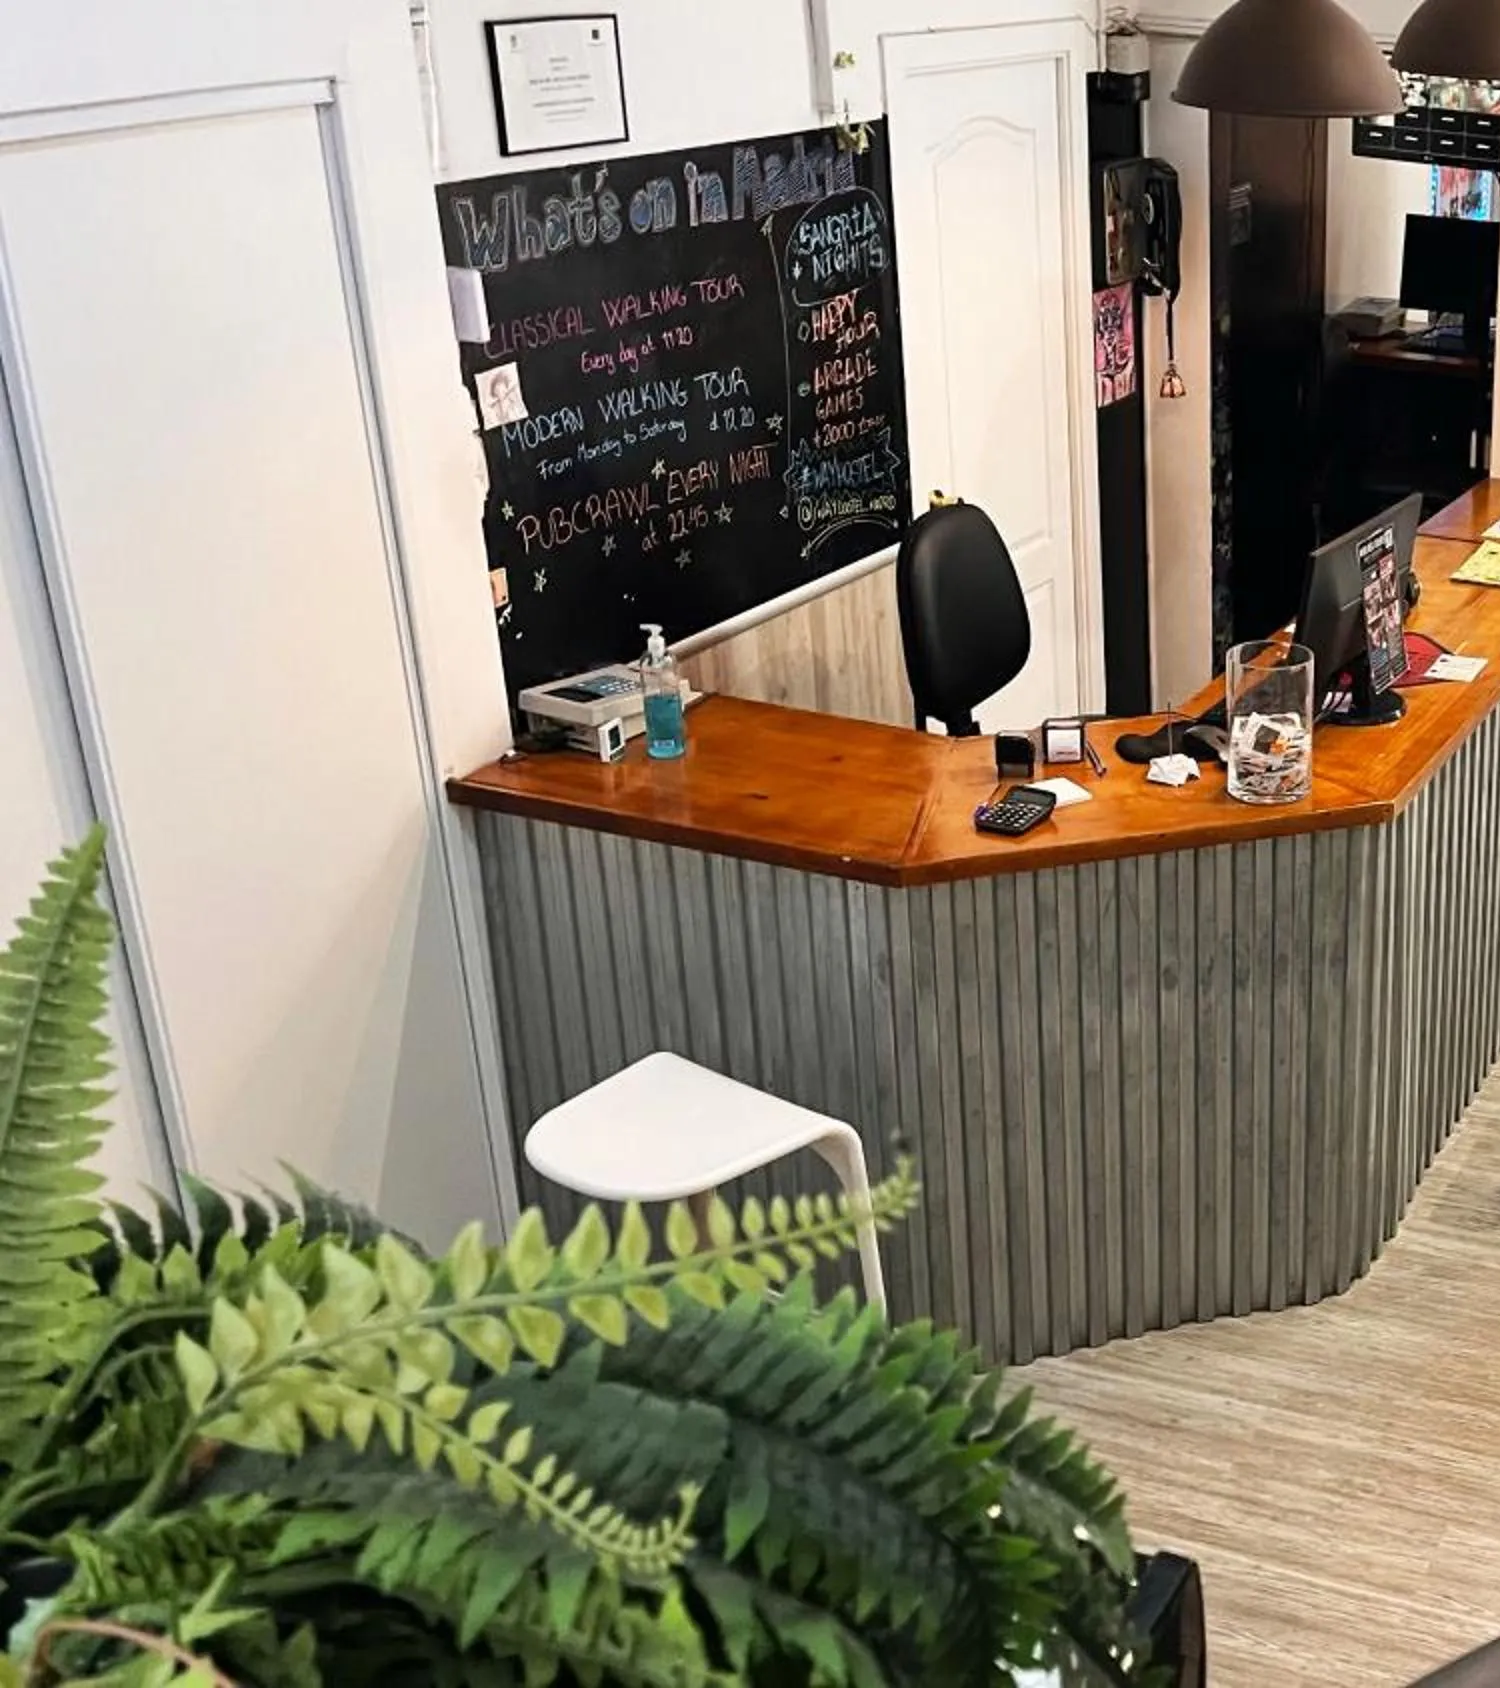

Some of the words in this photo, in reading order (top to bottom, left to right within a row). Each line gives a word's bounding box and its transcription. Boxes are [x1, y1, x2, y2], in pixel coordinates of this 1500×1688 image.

[452, 161, 623, 274] What's
[629, 176, 676, 234] on
[684, 160, 728, 227] in
[812, 233, 883, 281] NIGHTS
[484, 307, 595, 359] CLASSICAL
[602, 284, 686, 328] WALKING
[690, 274, 744, 304] TOUR
[811, 291, 856, 342] HAPPY
[581, 351, 616, 376] Every
[620, 339, 639, 373] day
[502, 407, 584, 457] MODERN
[598, 378, 688, 423] WALKING
[694, 367, 750, 400] TOUR
[816, 386, 863, 420] GAMES
[537, 457, 573, 481] From
[577, 440, 622, 463] Monday
[623, 428, 637, 444] to
[516, 483, 660, 554] PUBCRAWL
[667, 460, 719, 503] EVERY
[729, 442, 778, 483] NIGHT
[641, 519, 658, 552] at
